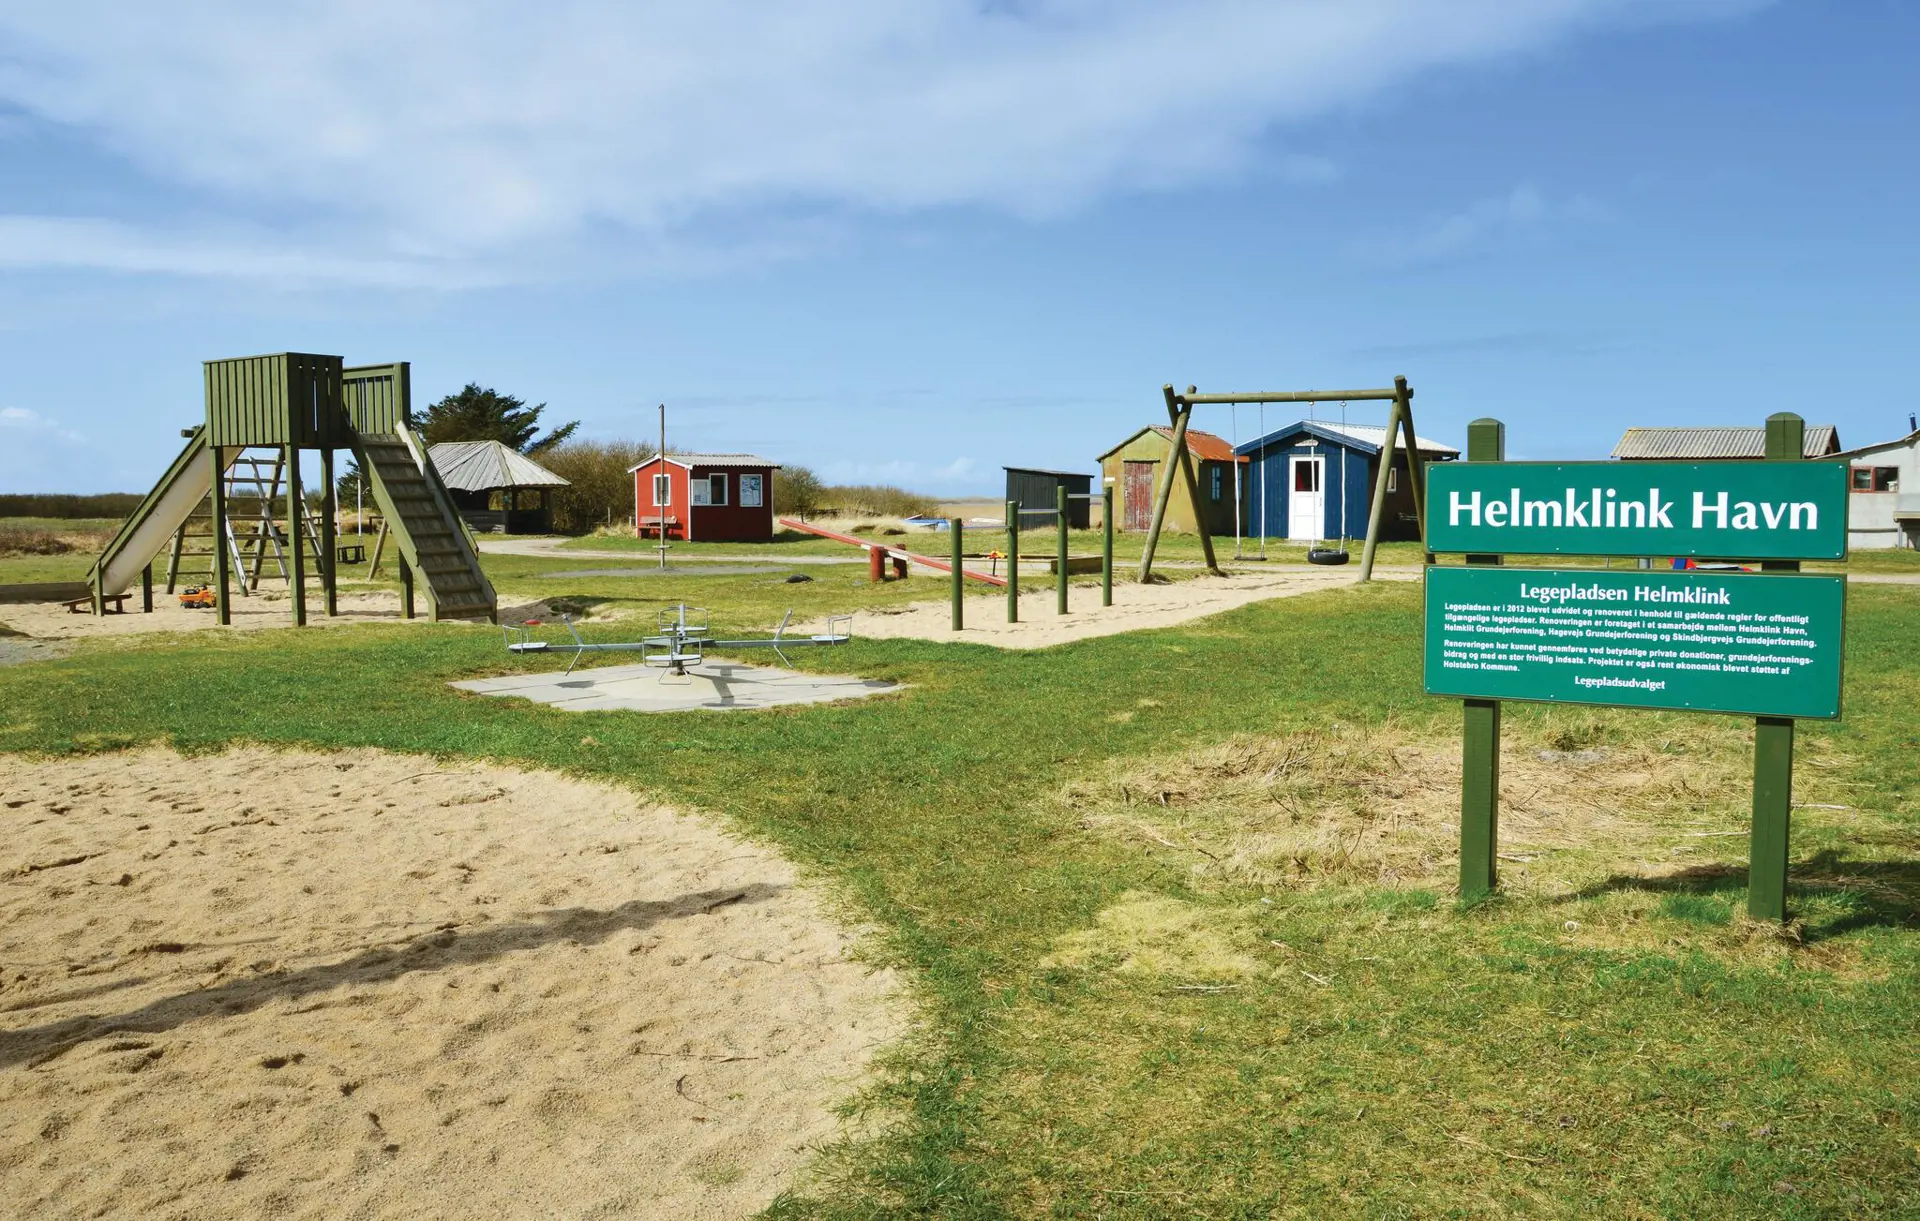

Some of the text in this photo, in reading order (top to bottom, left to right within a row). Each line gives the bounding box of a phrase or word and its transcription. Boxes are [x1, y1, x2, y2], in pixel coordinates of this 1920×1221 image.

[1450, 488, 1817, 529] Helmklink Havn
[1521, 583, 1730, 604] Legepladsen Helmklink
[1445, 602, 1491, 612] Legepladsen
[1526, 605, 1550, 613] blevet
[1552, 606, 1580, 614] udvidet
[1639, 609, 1672, 618] henhold
[1727, 613, 1752, 622] regler
[1769, 614, 1809, 625] offentligt
[1444, 623, 1817, 647] Helmklit Grundejerforening, Hagevejs Grundejerforening og Skindbjergvejs Grundejerforening.
[1492, 615, 1537, 624] legepladser.
[1539, 616, 1592, 627] Renoveringen
[1604, 619, 1640, 629] foretaget
[1657, 622, 1705, 632] samarbejde
[1706, 623, 1736, 632] mellem
[1739, 624, 1780, 634] Helmklink
[1783, 626, 1807, 636] Havn,
[1444, 640, 1494, 650] Renoveringen
[1510, 642, 1536, 651] kunnet
[1606, 647, 1647, 657] betydelige
[1649, 649, 1677, 658] private
[1679, 650, 1726, 661] donationer,
[1728, 654, 1813, 664] grundejerforenings-
[1444, 650, 1467, 660] bidrag
[1469, 652, 1478, 660] og
[1526, 654, 1553, 664] frivillig
[1555, 656, 1586, 664] indsats.
[1588, 657, 1624, 666] Projektet
[1723, 664, 1749, 672] blevet
[1443, 661, 1519, 671] Holstebro Kommune.
[1575, 676, 1665, 691] Legepladsudvalget
